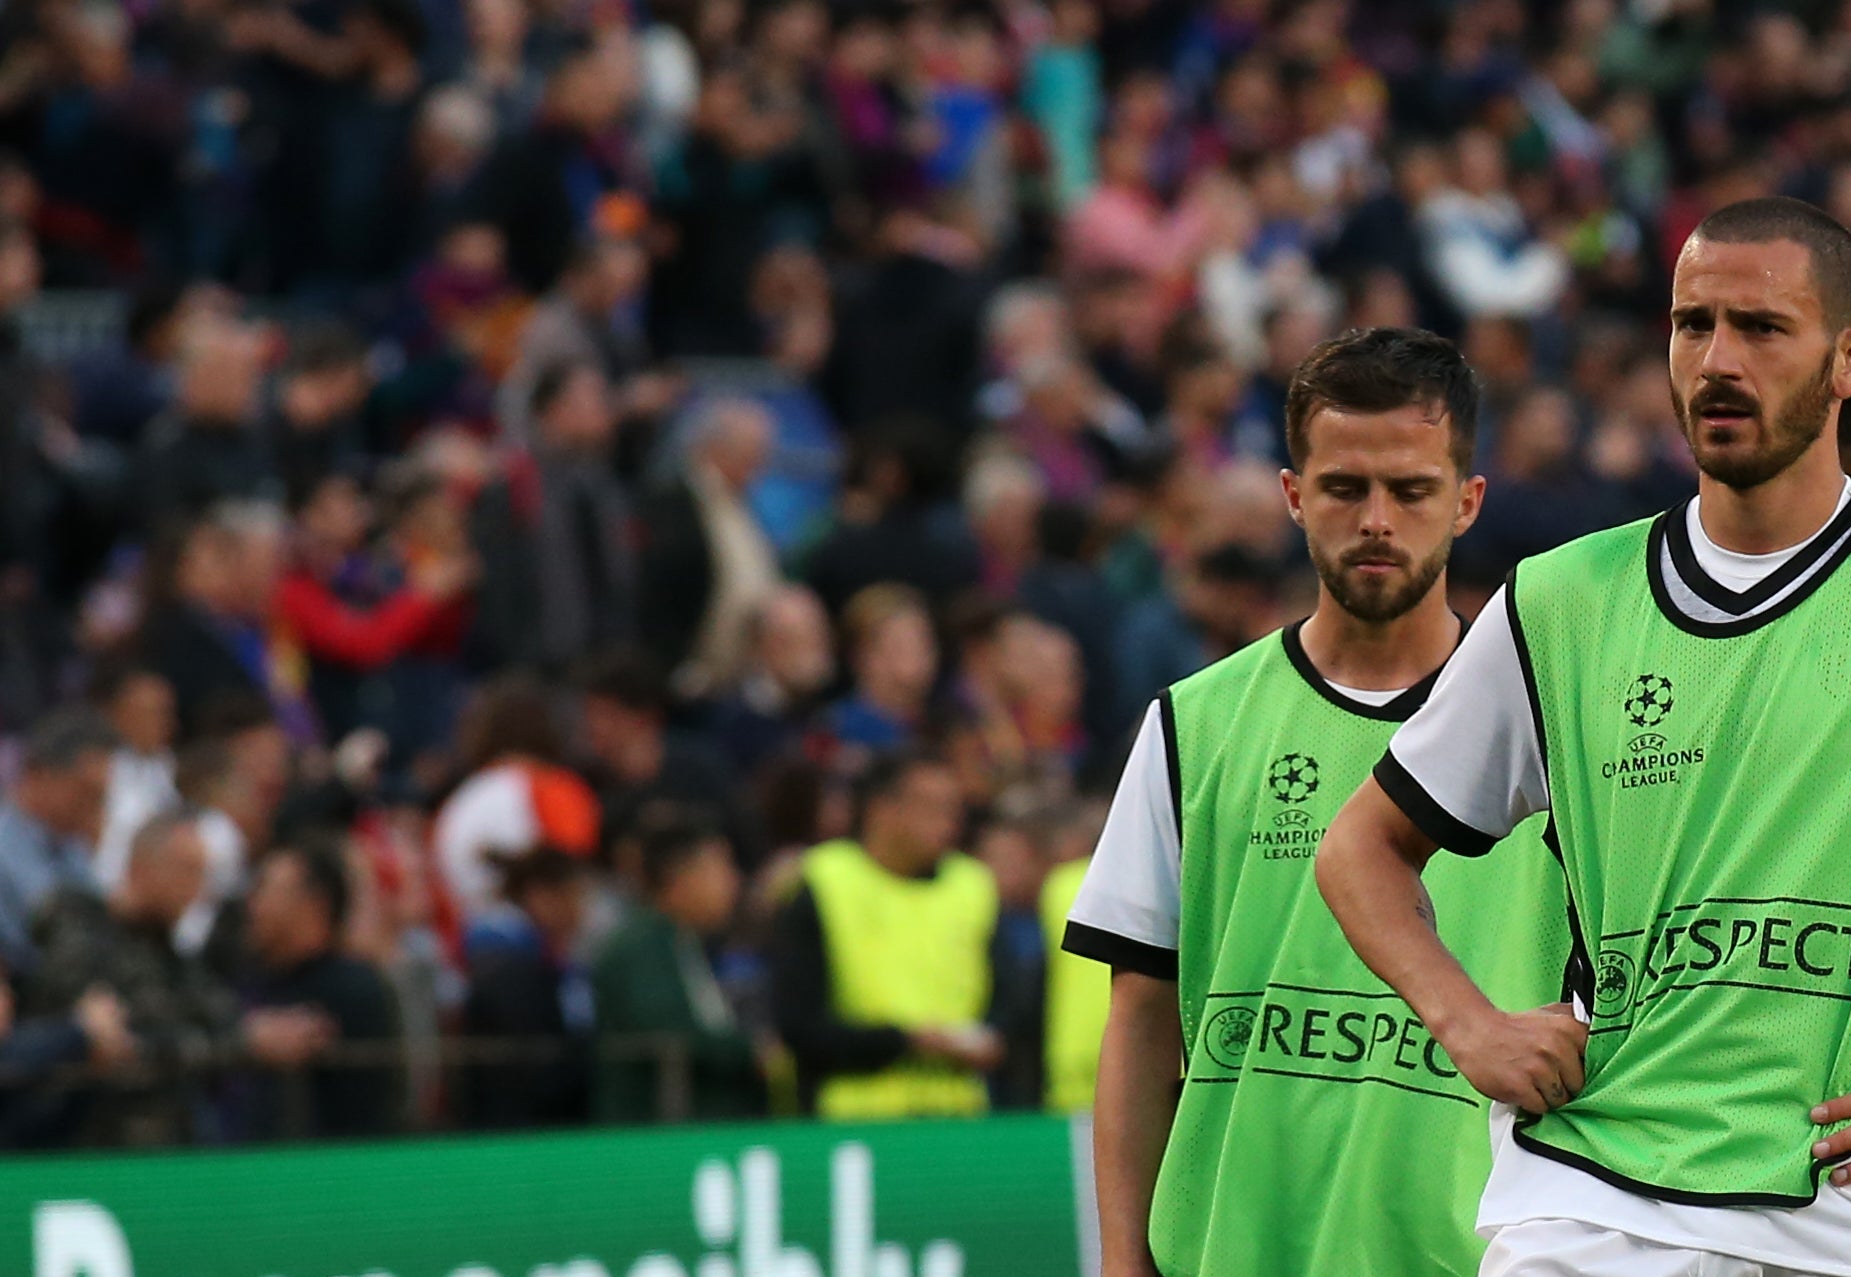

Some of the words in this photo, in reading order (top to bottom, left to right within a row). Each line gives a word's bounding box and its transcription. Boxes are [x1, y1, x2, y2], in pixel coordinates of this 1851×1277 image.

[1629, 736, 1665, 753] UEFA
[1621, 770, 1677, 789] LEAGUE
[1263, 847, 1316, 860] LEAGU
